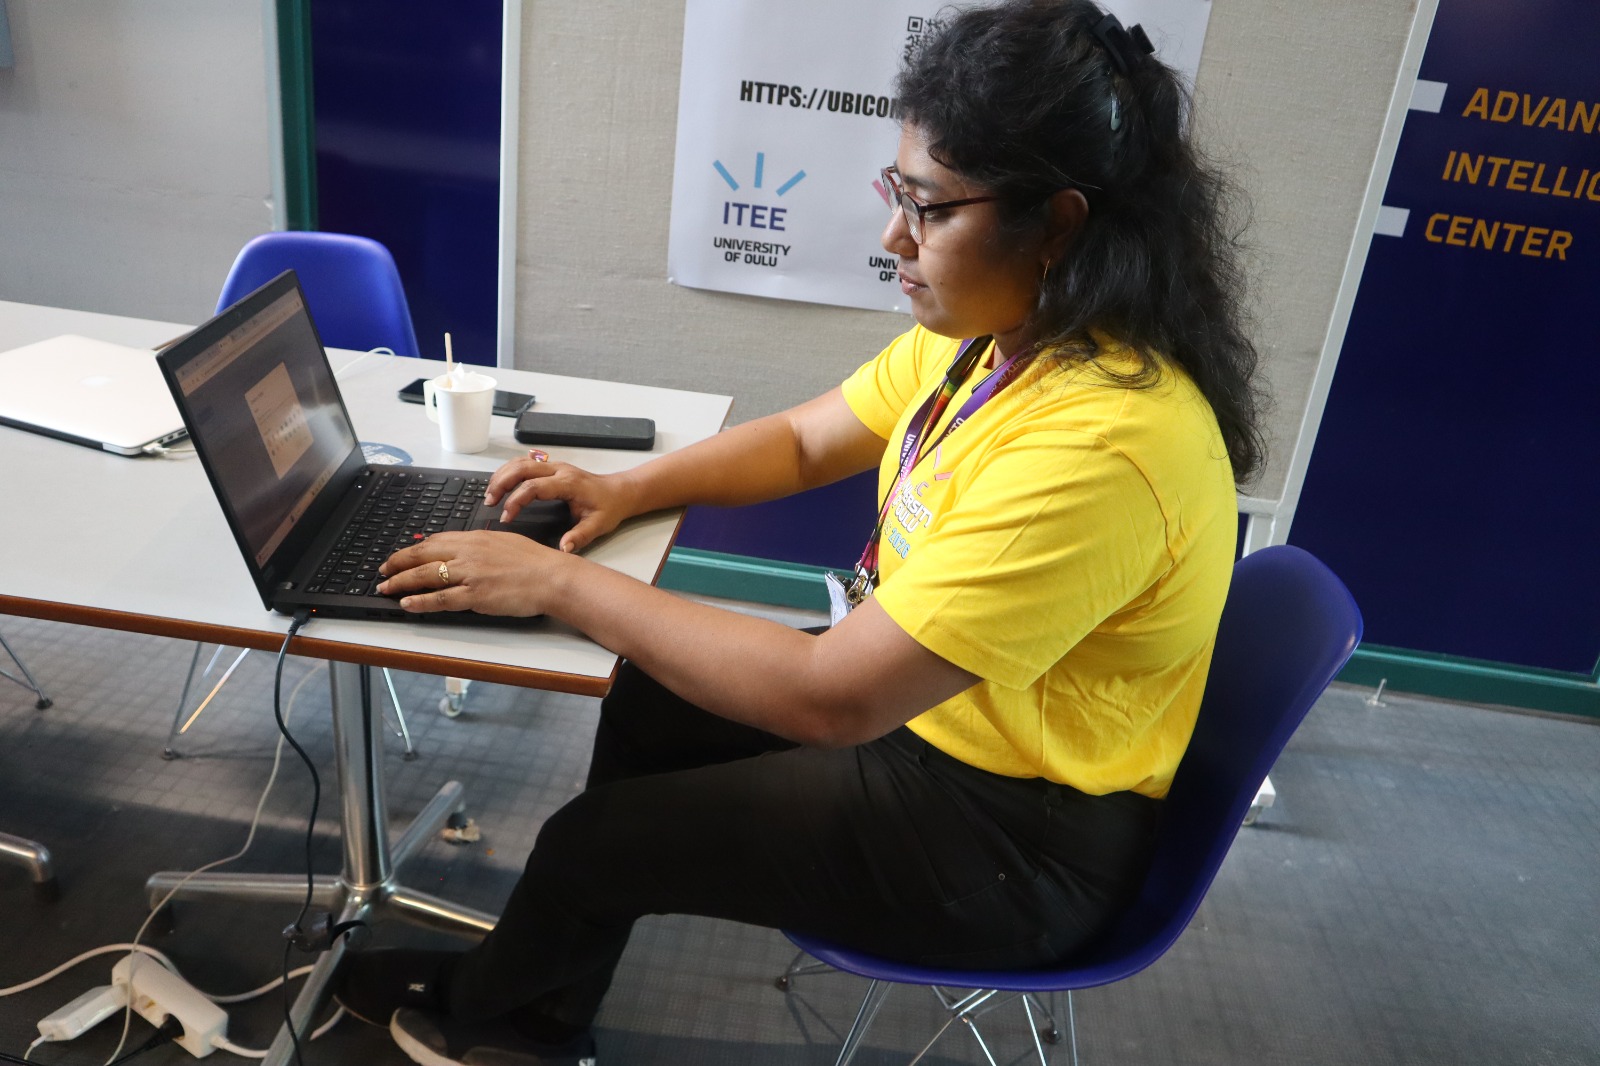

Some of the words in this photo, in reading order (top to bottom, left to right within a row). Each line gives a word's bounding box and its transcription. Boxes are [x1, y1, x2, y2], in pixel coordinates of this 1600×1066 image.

[1461, 87, 1600, 135] ADVAN
[722, 202, 787, 231] ITEE
[713, 237, 791, 256] UNIVERSITY
[1425, 213, 1573, 260] CENTER
[724, 251, 740, 264] OF
[744, 253, 777, 267] OULU
[869, 256, 899, 270] UNIV
[879, 270, 896, 282] OF
[888, 528, 911, 559] 2026
